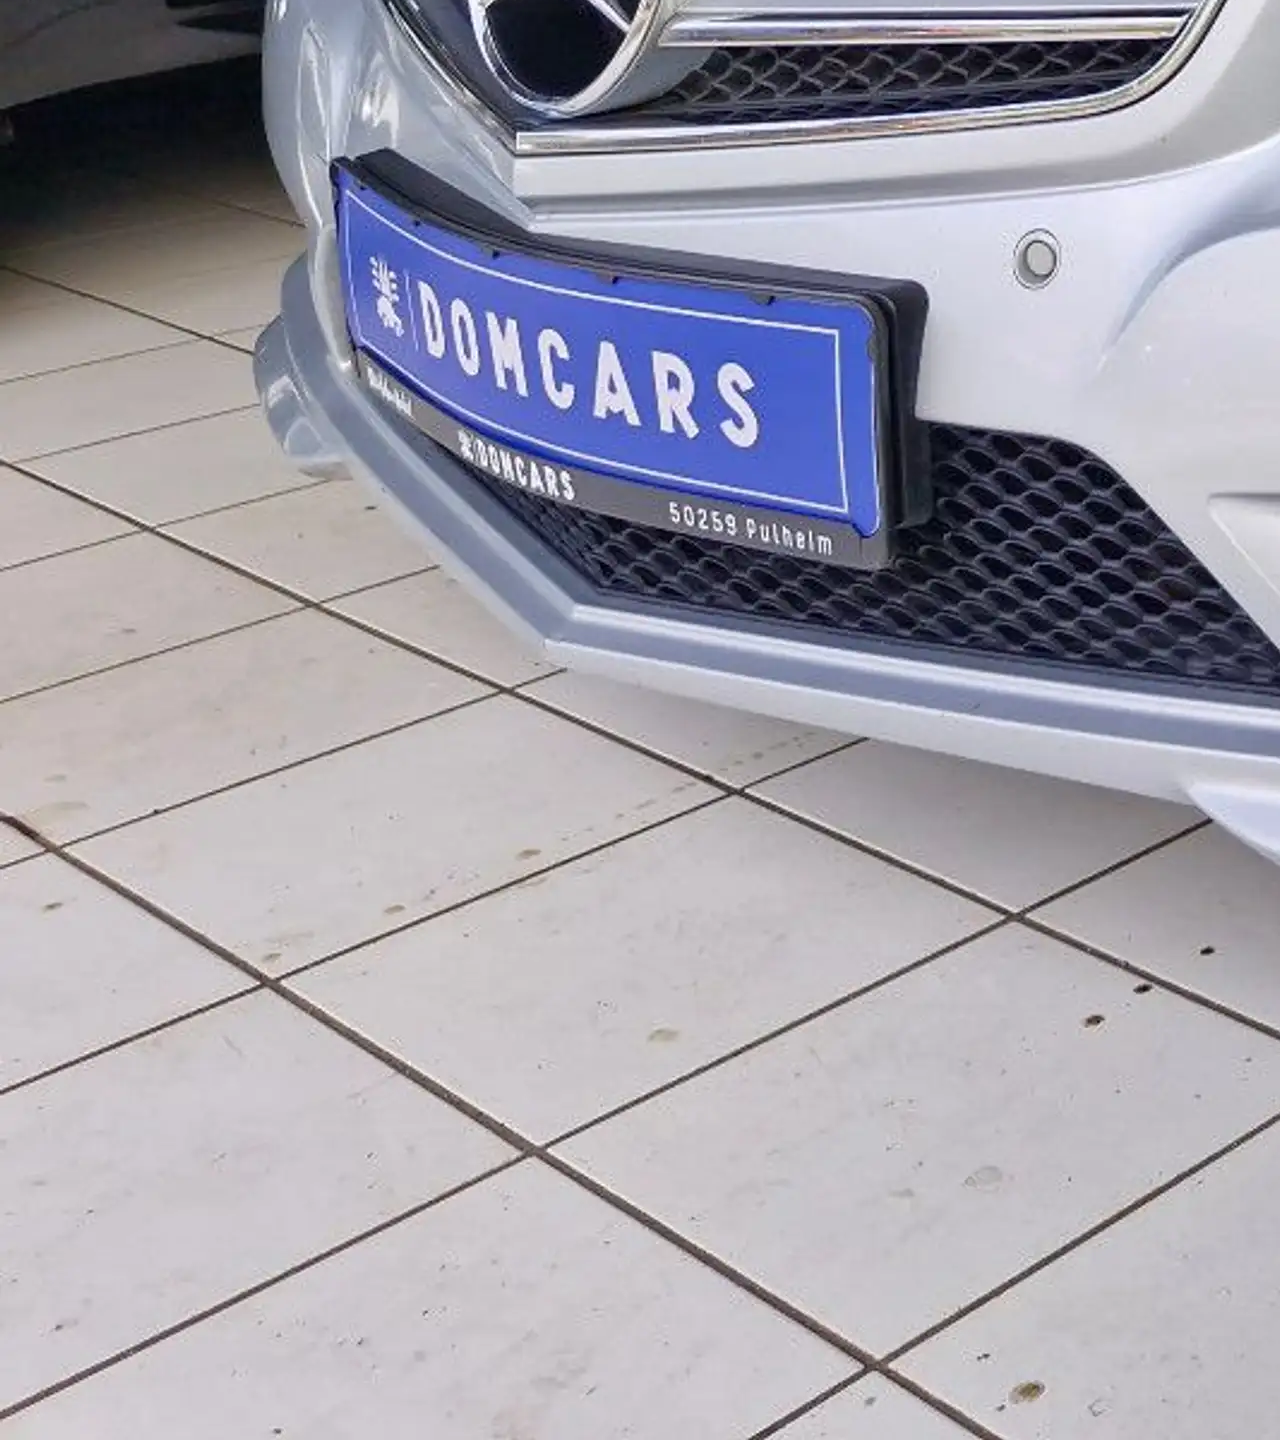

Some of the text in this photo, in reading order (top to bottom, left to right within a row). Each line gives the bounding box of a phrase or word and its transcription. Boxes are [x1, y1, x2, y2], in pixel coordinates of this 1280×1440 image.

[417, 280, 760, 448] DOMCARS
[477, 439, 576, 501] DOMCARS
[668, 501, 737, 537] 50259
